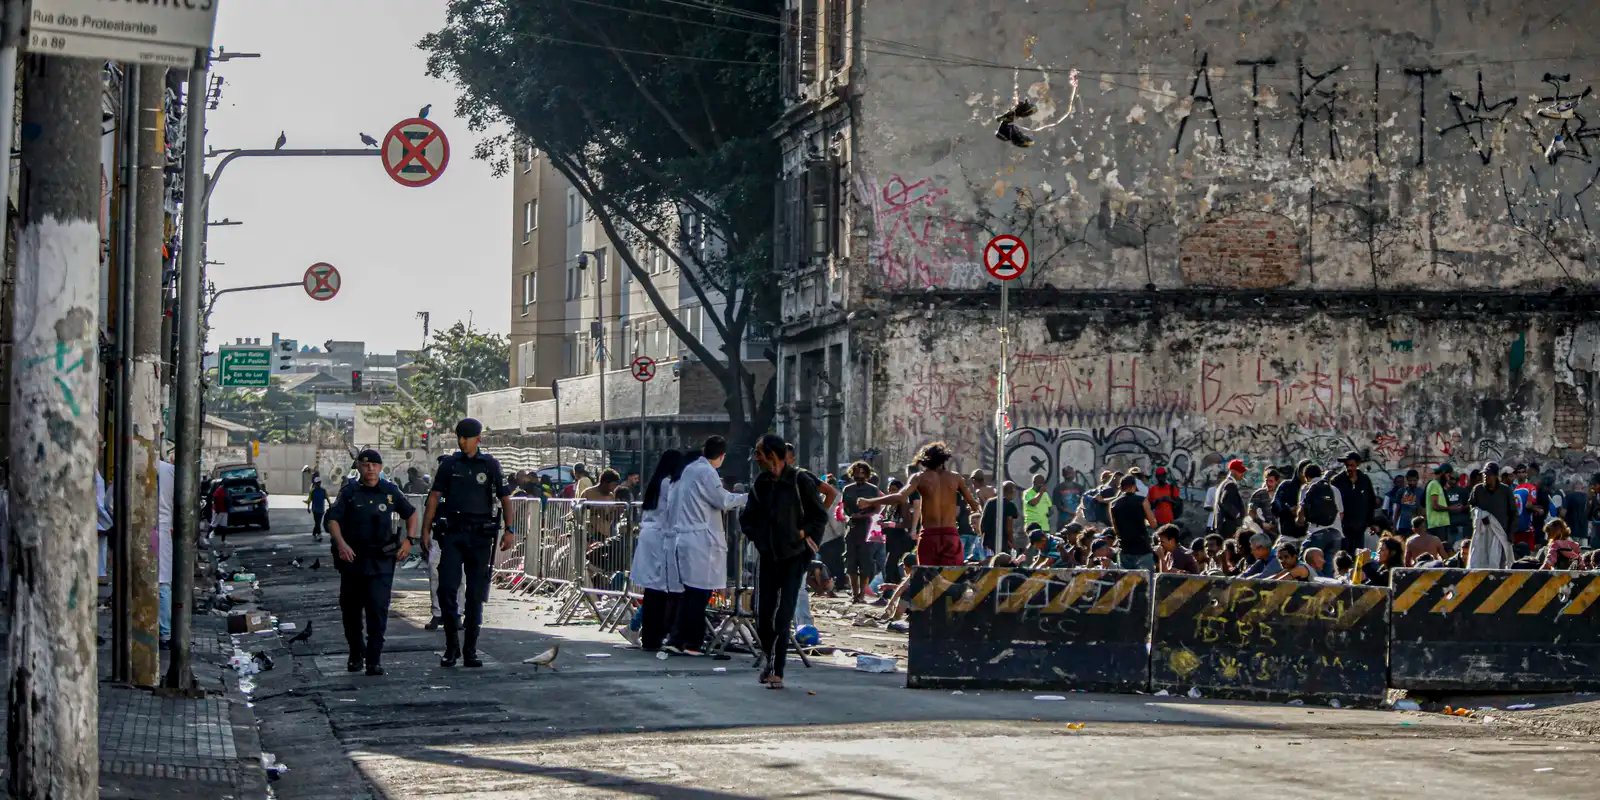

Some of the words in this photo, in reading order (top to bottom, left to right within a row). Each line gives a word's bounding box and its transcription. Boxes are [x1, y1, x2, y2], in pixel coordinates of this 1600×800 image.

[33, 10, 53, 24] Rua
[57, 14, 78, 27] dos
[82, 15, 158, 35] Protestantes
[31, 35, 39, 46] 9
[41, 38, 48, 47] a
[51, 37, 66, 49] 89
